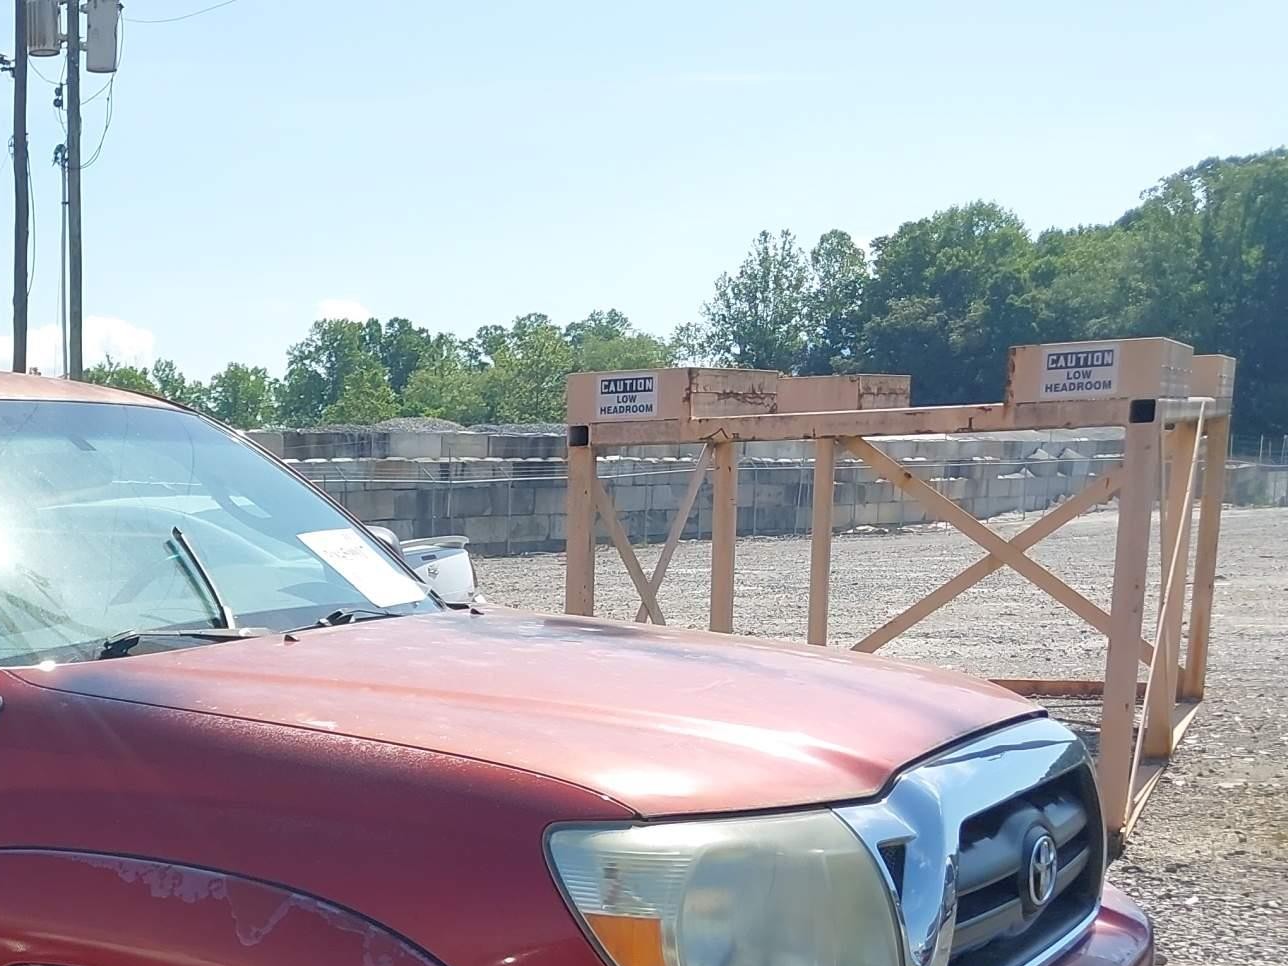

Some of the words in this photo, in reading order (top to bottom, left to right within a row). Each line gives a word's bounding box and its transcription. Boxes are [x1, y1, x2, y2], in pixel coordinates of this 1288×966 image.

[1047, 350, 1113, 369] CAUTION
[1066, 370, 1093, 381] LOW
[601, 378, 653, 393] CAUTION
[1044, 380, 1112, 393] HEADROOM
[616, 394, 637, 404] LOW
[599, 404, 653, 415] HEADROOM
